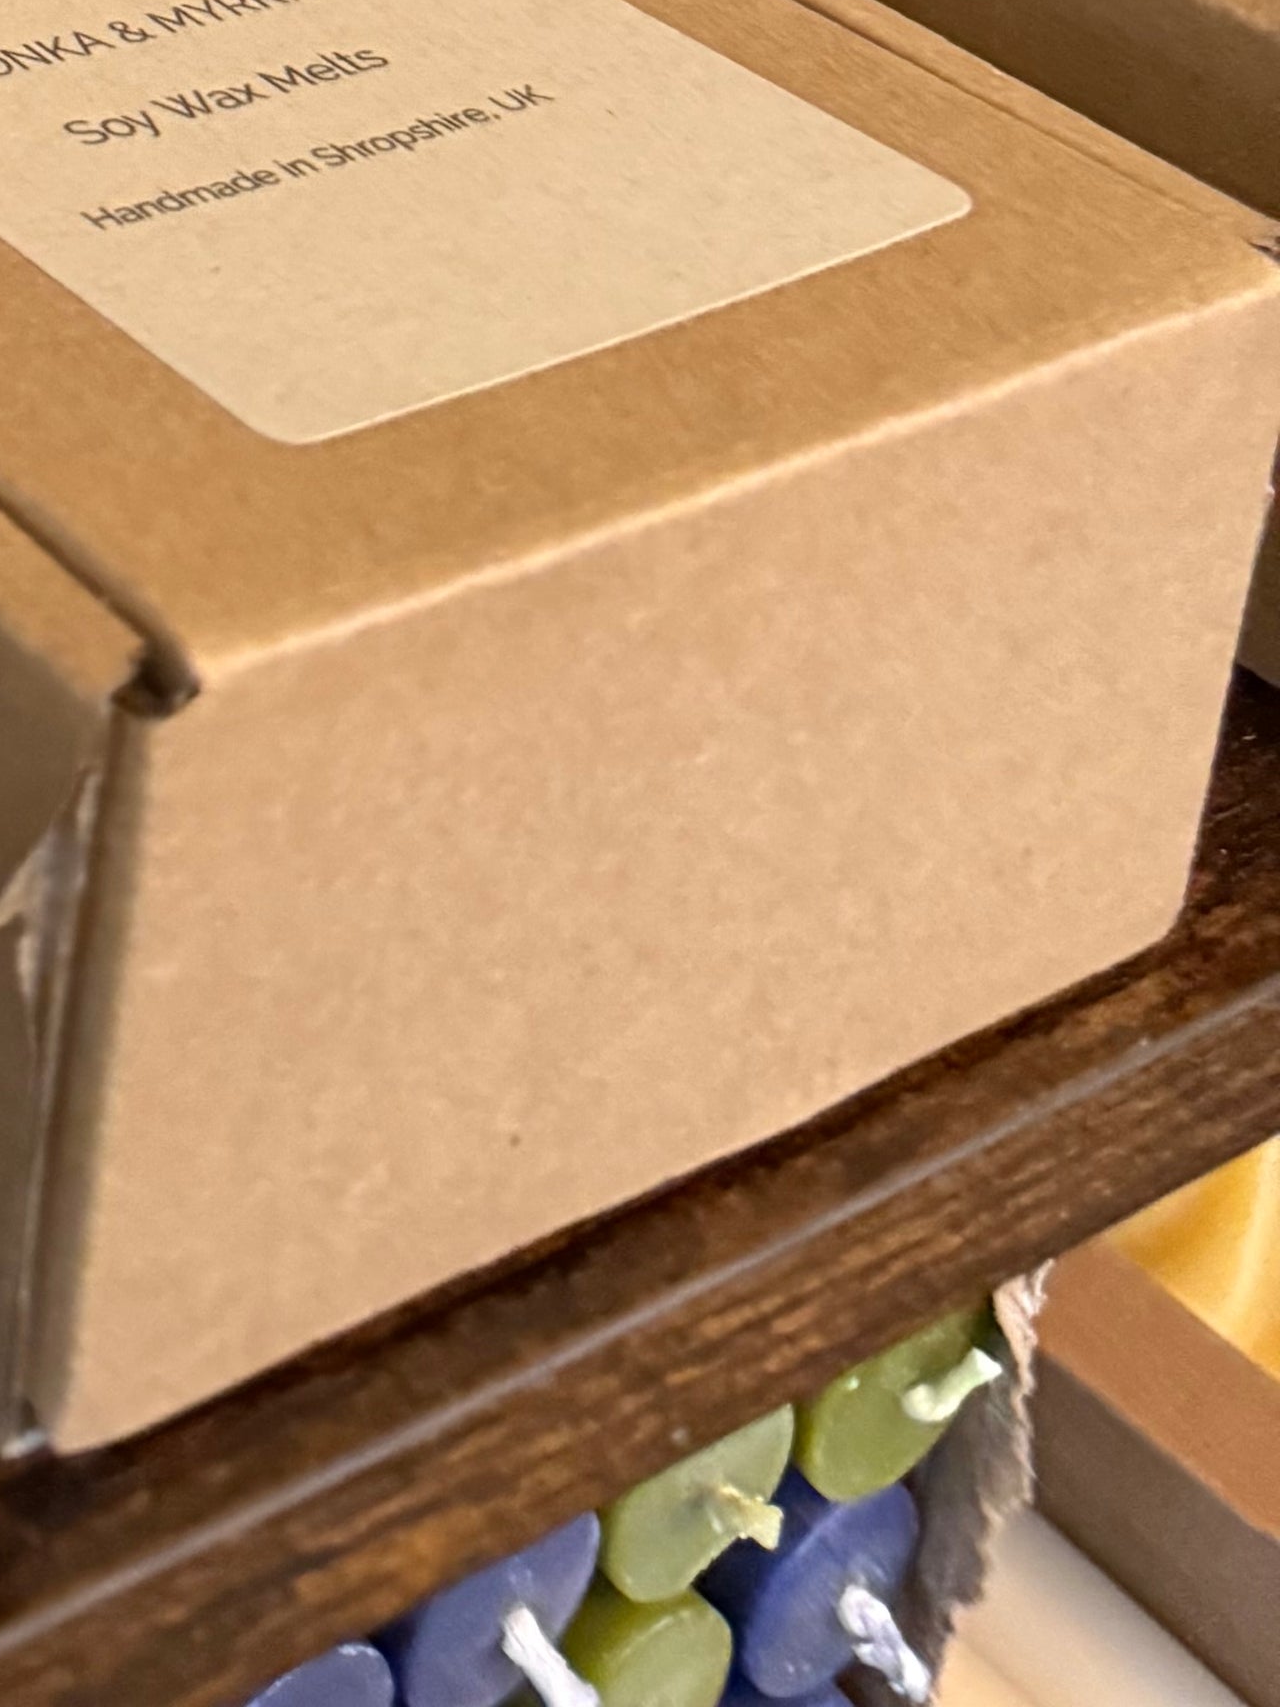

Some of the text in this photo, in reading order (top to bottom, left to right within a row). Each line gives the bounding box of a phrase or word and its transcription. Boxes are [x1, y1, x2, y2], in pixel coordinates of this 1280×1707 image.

[107, 19, 154, 47] &
[62, 43, 392, 148] Soy Wax Melts
[80, 82, 556, 232] Handmade in Shropshire, UK
